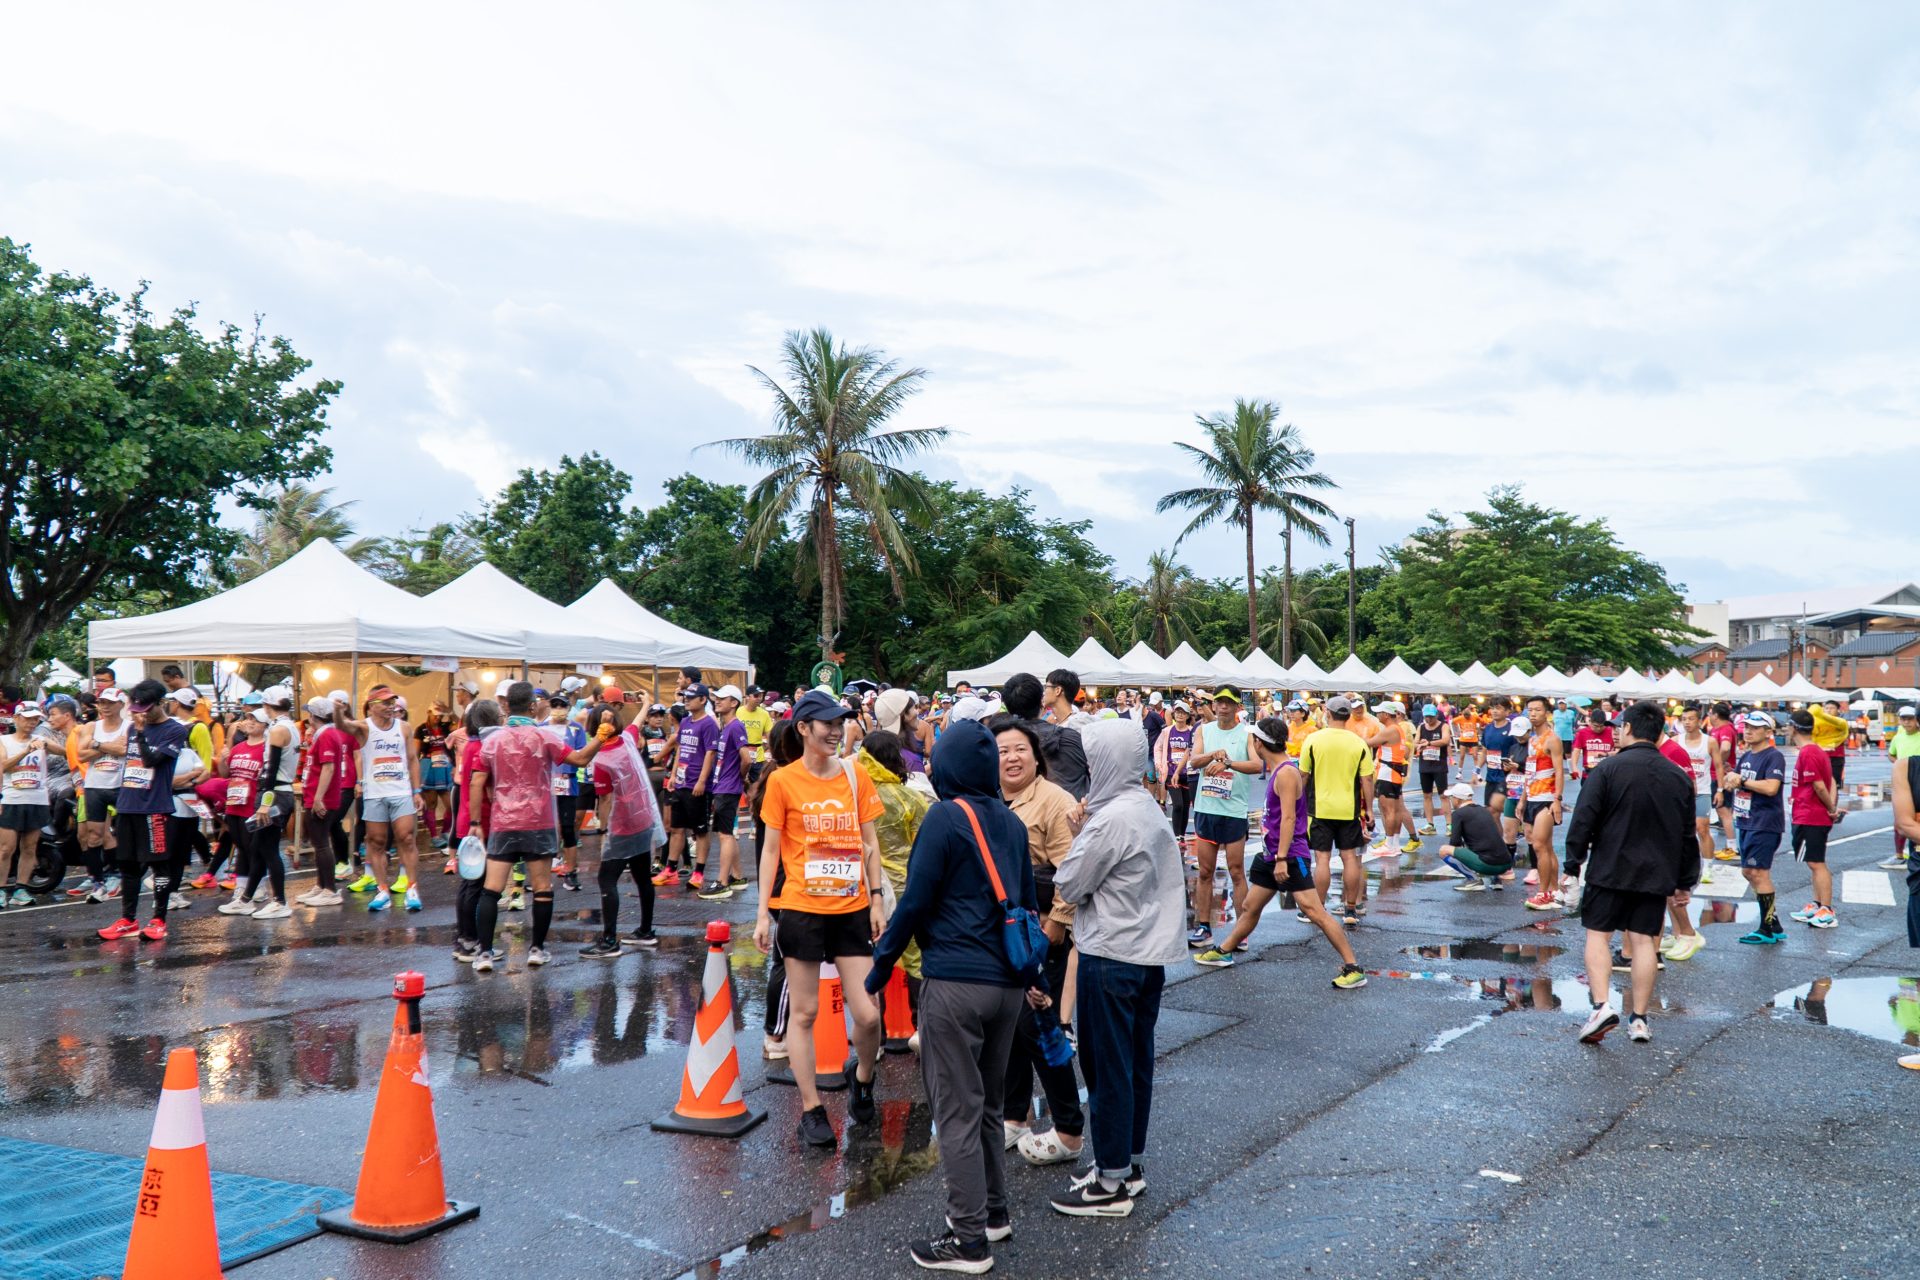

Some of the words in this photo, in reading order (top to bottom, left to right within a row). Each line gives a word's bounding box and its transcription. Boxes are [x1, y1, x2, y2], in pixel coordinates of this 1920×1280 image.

[372, 739, 399, 751] Taipei
[1209, 777, 1228, 787] 3035
[822, 863, 852, 875] 5217
